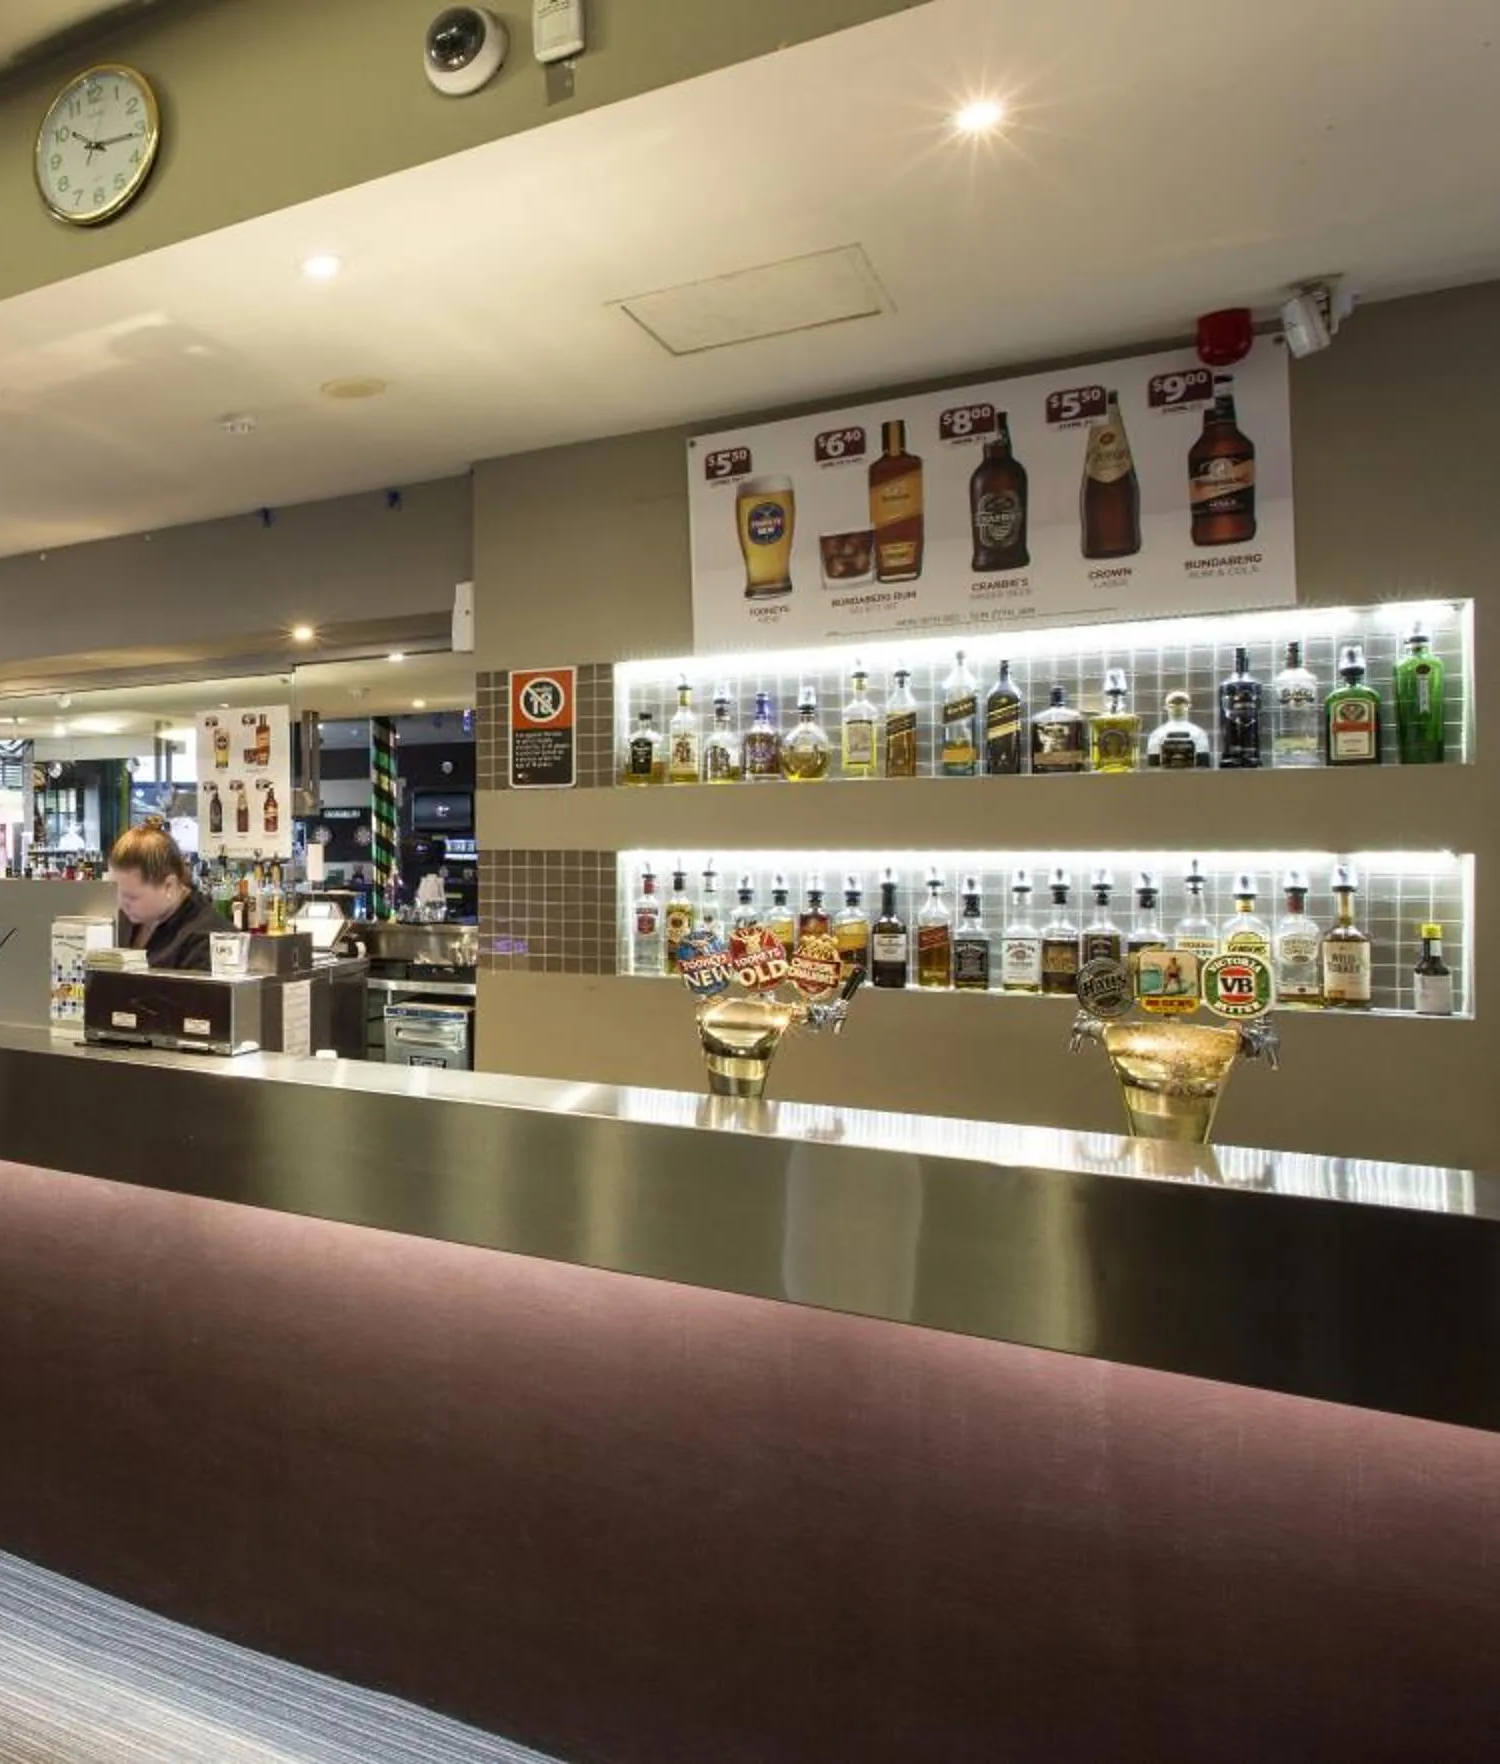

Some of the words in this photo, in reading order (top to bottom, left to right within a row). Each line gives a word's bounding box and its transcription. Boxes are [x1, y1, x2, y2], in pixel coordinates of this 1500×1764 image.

[114, 85, 119, 100] 1
[68, 101, 81, 118] 11
[127, 97, 139, 115] 2
[55, 125, 69, 144] 10
[51, 154, 62, 170] 9
[129, 150, 140, 164] 4
[58, 176, 68, 192] 8
[73, 189, 84, 206] 7
[1185, 553, 1263, 570] BUNDABERG
[1088, 567, 1132, 580] CROWN
[894, 589, 917, 600] RUM
[739, 959, 789, 987] OLD
[1208, 956, 1262, 974] VICTORIA
[684, 963, 732, 988] NEW
[1220, 978, 1253, 994] VB
